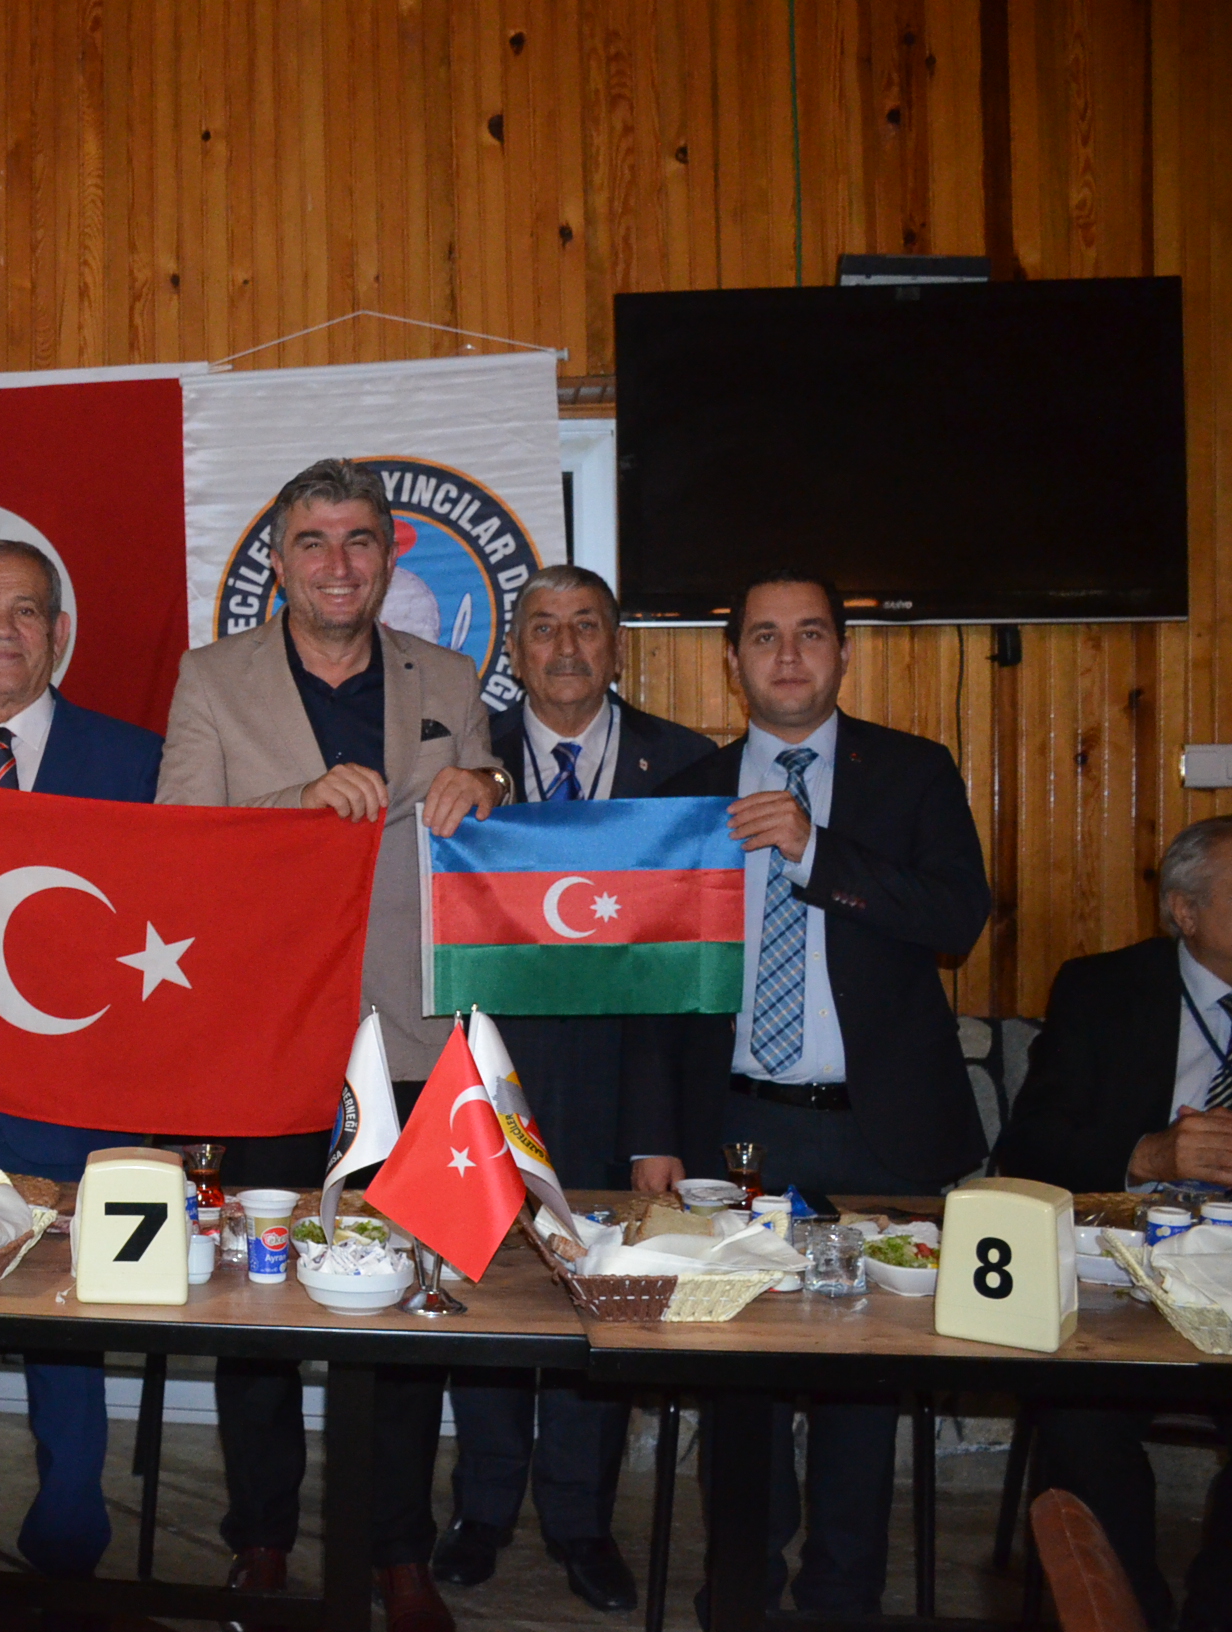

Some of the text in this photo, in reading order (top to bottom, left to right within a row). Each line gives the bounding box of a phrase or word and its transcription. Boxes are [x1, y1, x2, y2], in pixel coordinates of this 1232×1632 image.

[380, 470, 517, 565] YINCILAR
[104, 1202, 168, 1262] 7
[973, 1236, 1013, 1300] 8
